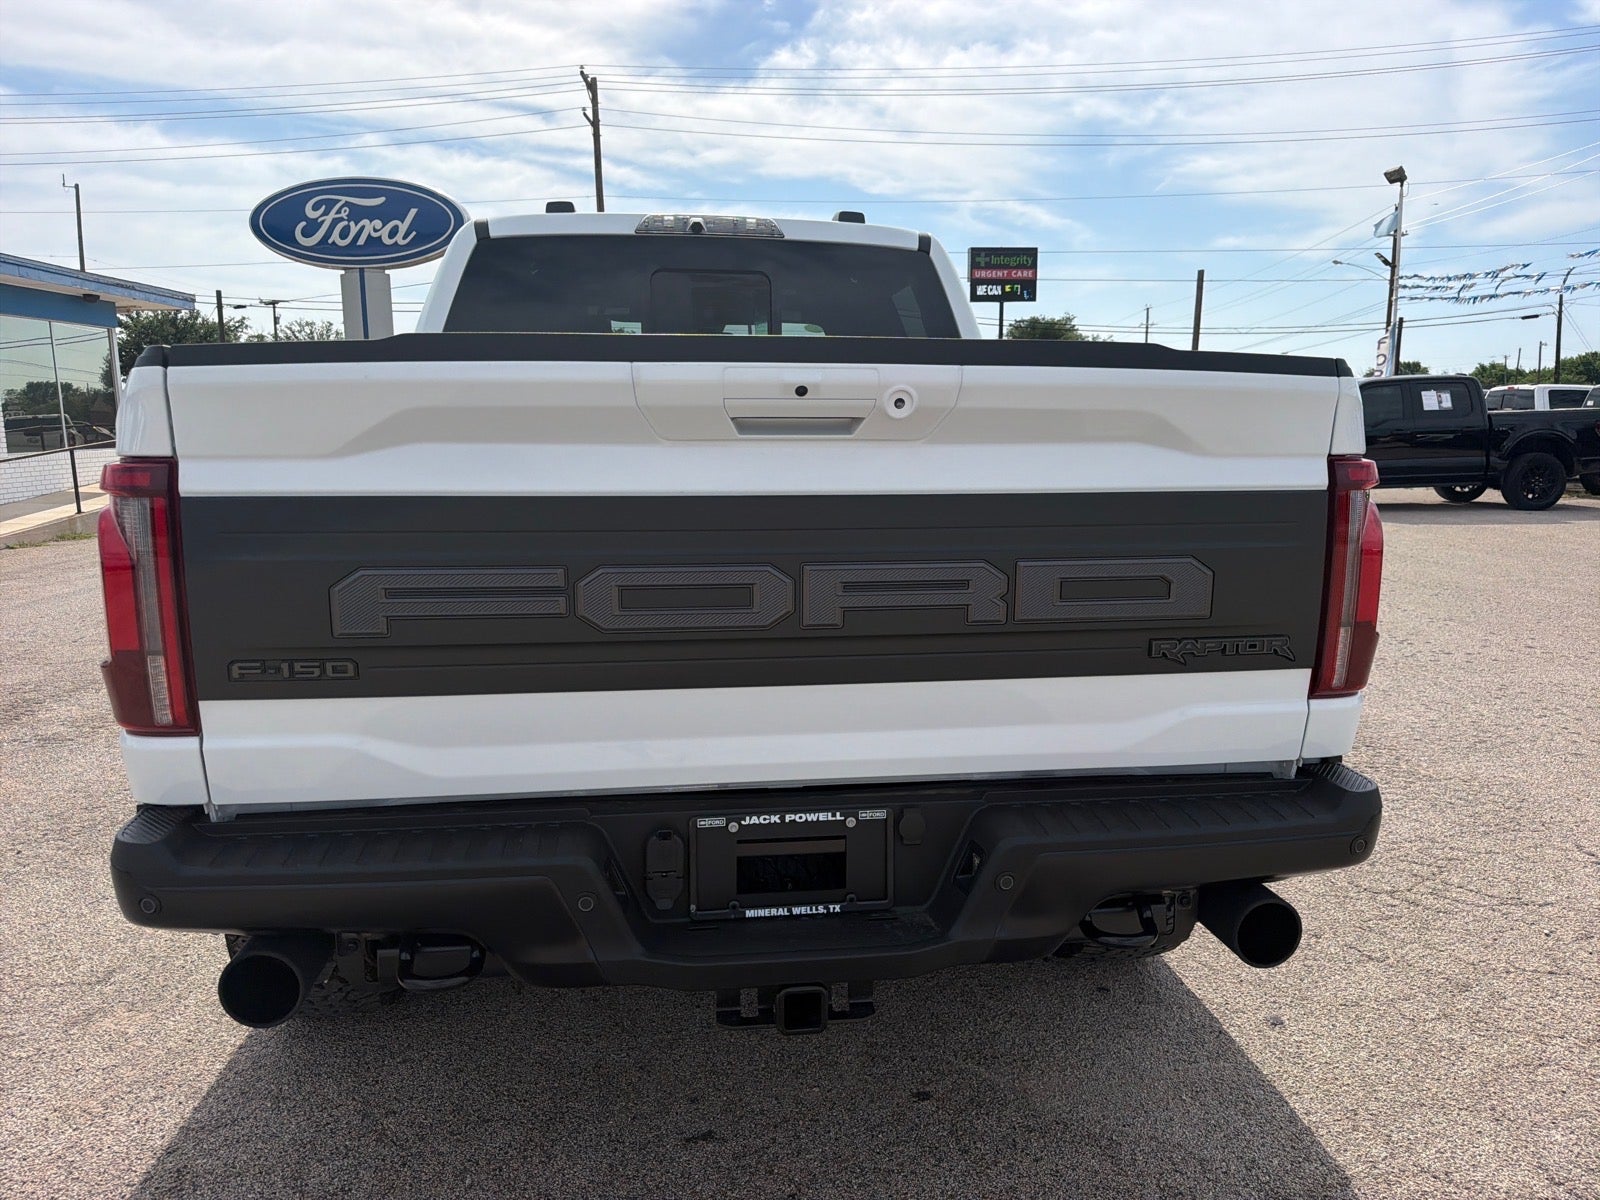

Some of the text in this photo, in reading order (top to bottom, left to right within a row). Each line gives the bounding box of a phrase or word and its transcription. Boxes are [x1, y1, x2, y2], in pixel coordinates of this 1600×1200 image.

[294, 194, 419, 247] Ford
[991, 255, 1033, 266] Integrity
[975, 270, 1033, 278] URGENT CARE
[329, 556, 1215, 637] FORD
[1149, 634, 1295, 665] RAPTOR
[229, 660, 358, 681] F-150
[741, 811, 845, 826] JACK POWELL
[745, 905, 841, 918] MINERAL WELLS, TX
